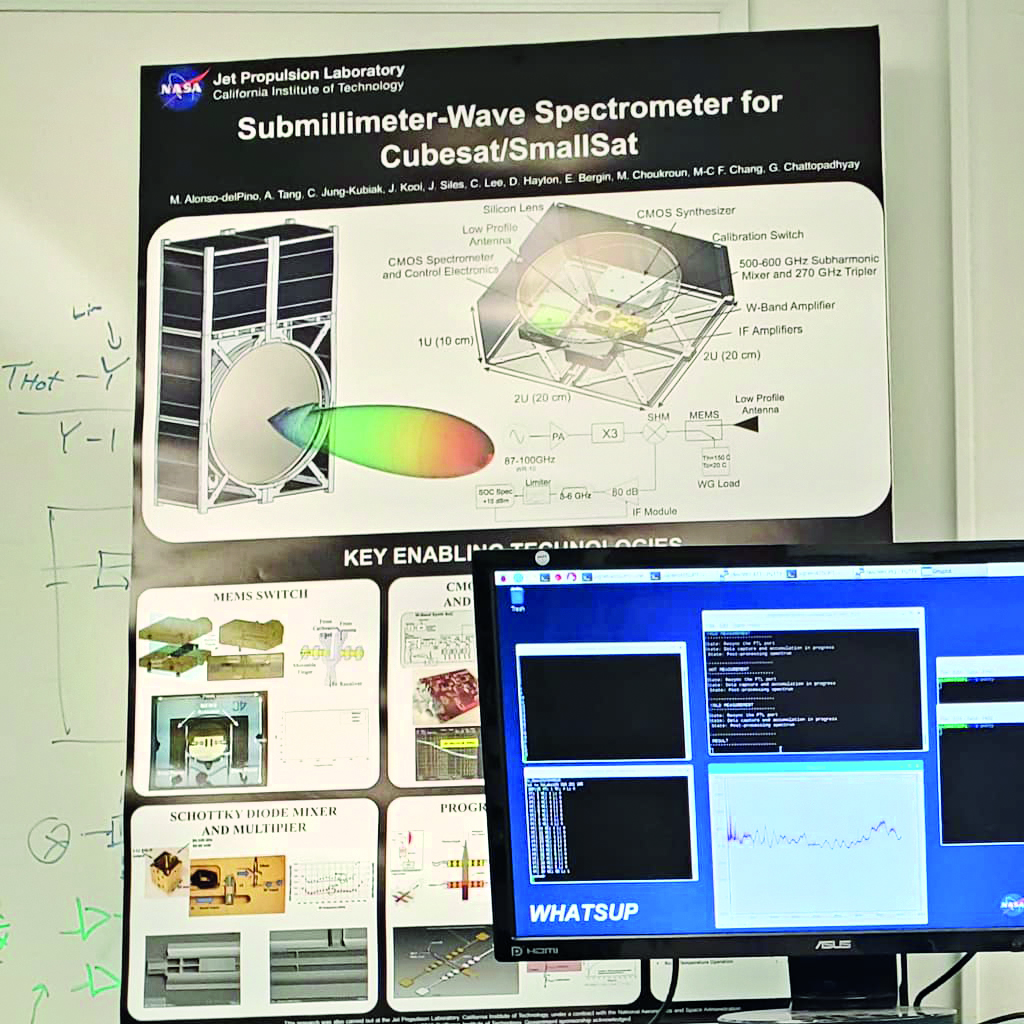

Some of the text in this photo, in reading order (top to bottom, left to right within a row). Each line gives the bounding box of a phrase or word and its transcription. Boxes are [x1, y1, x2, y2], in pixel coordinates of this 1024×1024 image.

[212, 64, 405, 86] Jet Propulsion Laboratory
[160, 81, 203, 96] NASA
[212, 80, 405, 101] California Institute of Technology
[237, 91, 784, 141] Submillimeter-Wave Spectrometer for
[380, 132, 639, 169] Cubesat/SmallSat
[184, 159, 861, 204] Alonso-delPino, Tang, Jung-Kubiak, Kooi, Siles, Lee, Bergin, Choukroun, M-C Chang, Chattopadhyay
[482, 203, 545, 215] Silicon Lens
[636, 207, 735, 220] CMOS Synthesizer
[462, 222, 518, 235] Low Profile
[711, 229, 804, 243] Calibration Switch
[388, 253, 494, 268] CMOS Spectrometer
[739, 255, 880, 269] 500-600 GHz Subharmonic
[382, 267, 442, 280] and Control
[741, 266, 877, 281] Mixer and 270 GHz Tripler
[745, 300, 836, 314] W-Band Amplifier
[752, 325, 803, 337] Amplifiers
[434, 335, 474, 348] (10 cm)
[721, 349, 761, 363] (20 cm)
[531, 391, 572, 404] (20 cm)
[735, 393, 785, 404] Low Profile
[689, 410, 720, 420] MEMS
[741, 405, 780, 415] Antenna
[647, 412, 670, 422] SHM
[552, 432, 565, 441] PA
[601, 428, 619, 439] X3
[504, 456, 556, 466] 87-100GHz
[717, 479, 741, 489] Load
[632, 507, 678, 517] IF Module
[343, 549, 388, 568] KEY
[213, 587, 309, 603] MEMS SWITCH
[443, 596, 472, 607] AND
[169, 806, 337, 822] SCHOTTKY DIODE MIXER
[529, 902, 640, 923] WHATSUP
[526, 946, 559, 955] HDMI
[815, 940, 852, 950] ASUS
